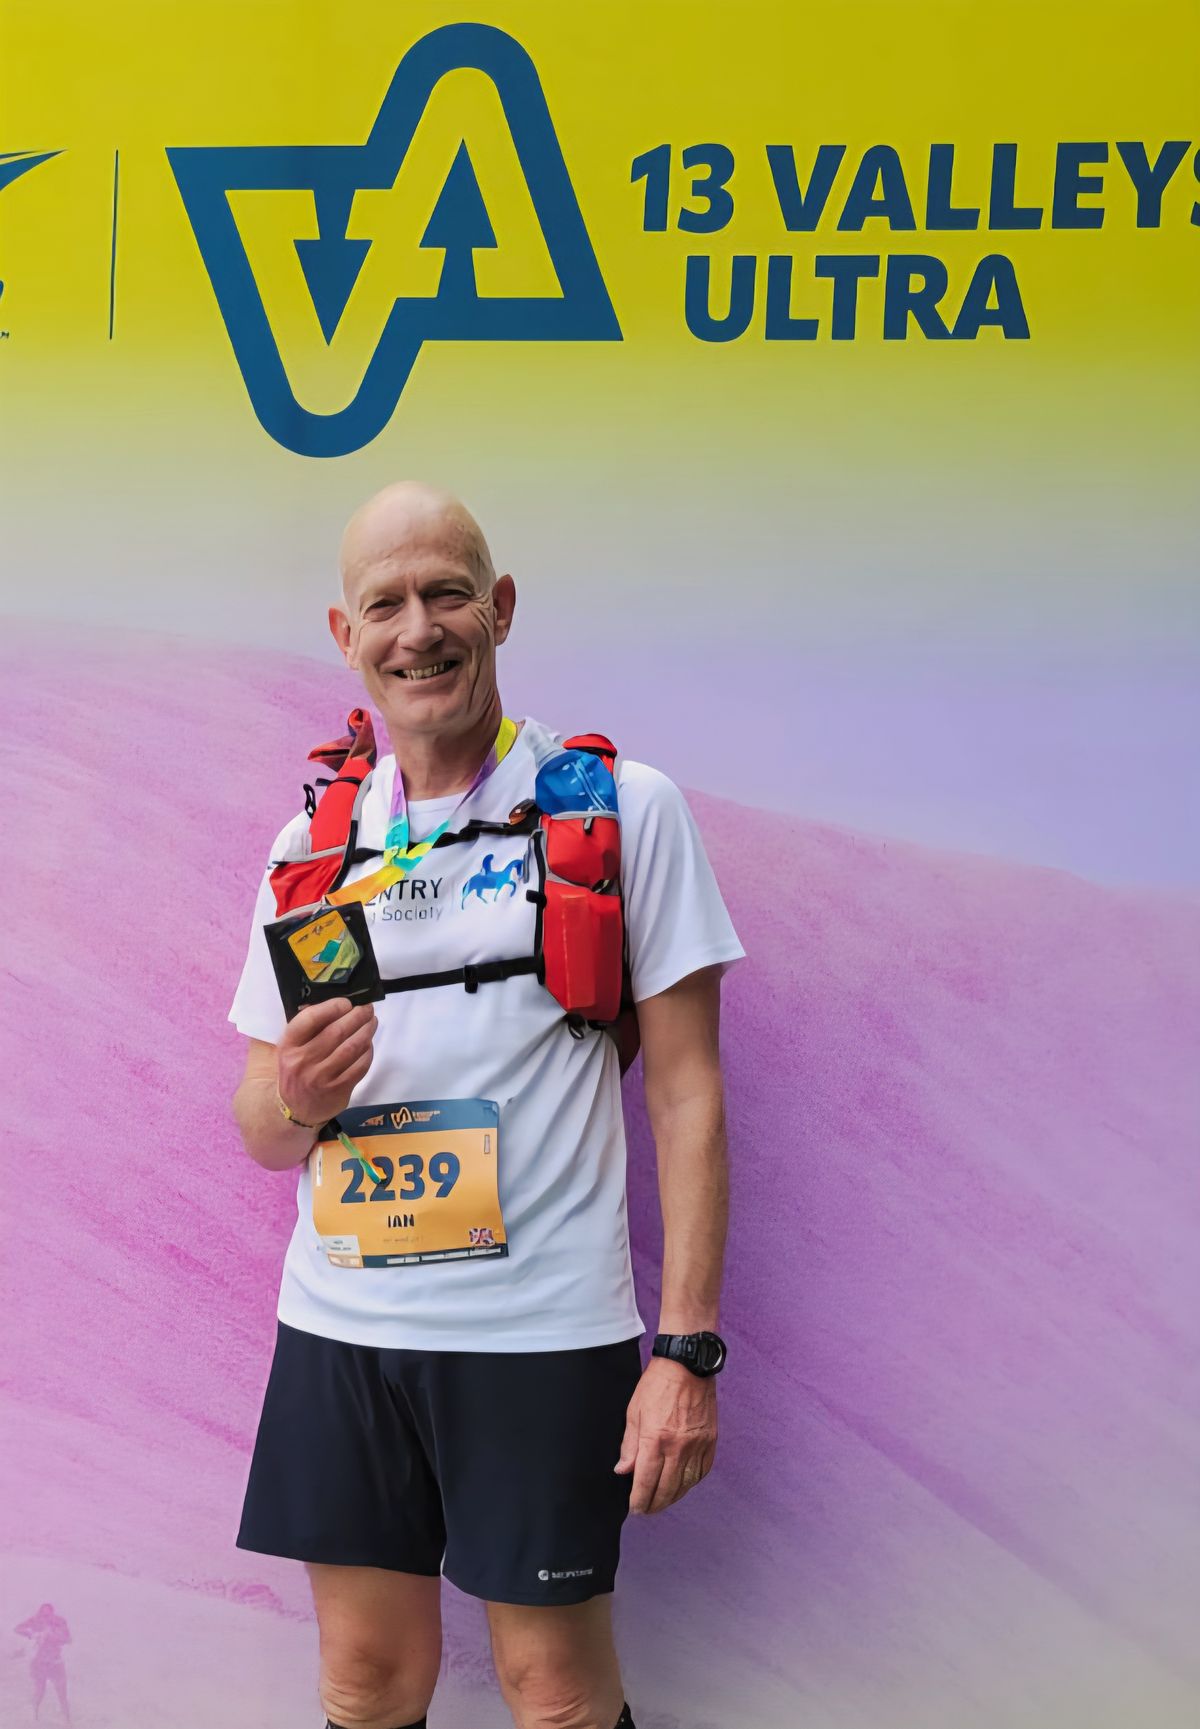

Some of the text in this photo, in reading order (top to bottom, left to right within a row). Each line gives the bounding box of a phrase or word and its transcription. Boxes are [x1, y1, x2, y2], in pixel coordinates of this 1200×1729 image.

[632, 142, 1200, 233] 13 VALLEY
[685, 254, 1029, 342] ULTRA
[340, 1151, 461, 1204] 2239
[387, 1213, 415, 1229] IAN
